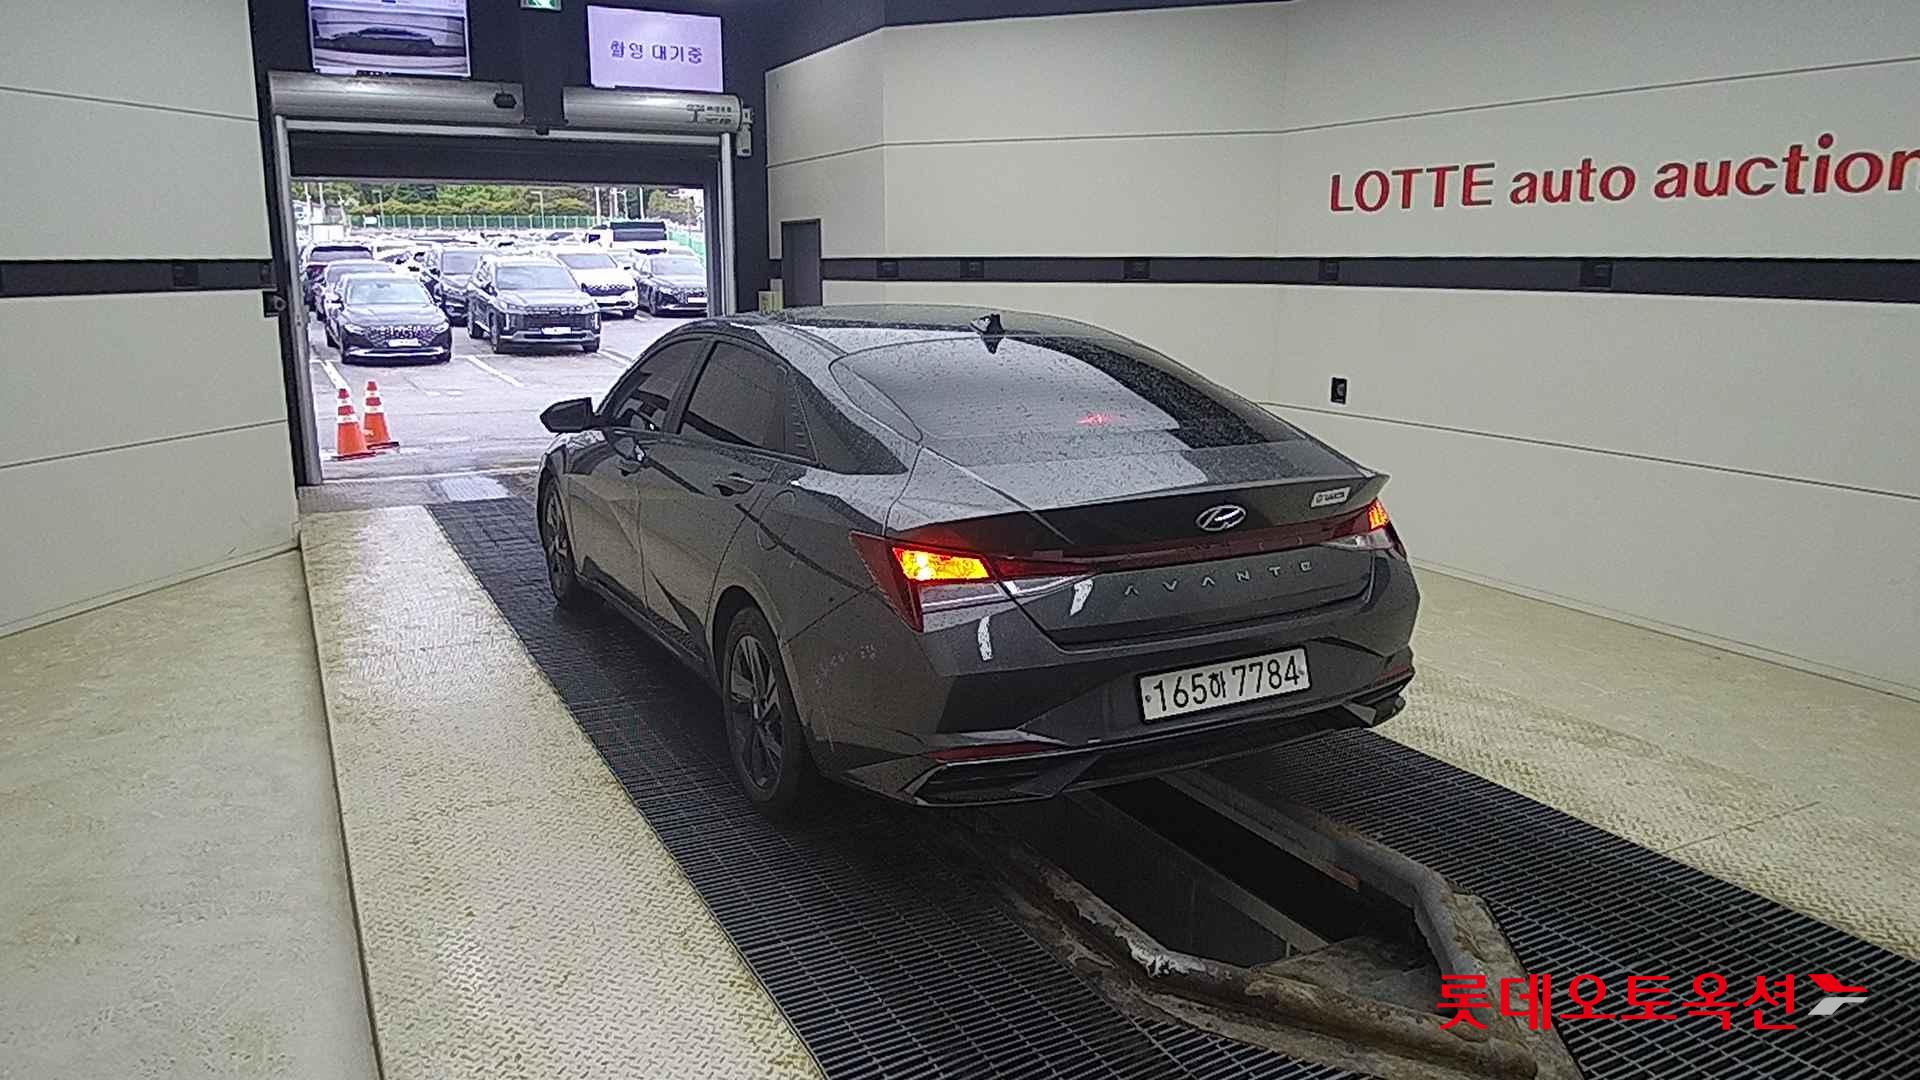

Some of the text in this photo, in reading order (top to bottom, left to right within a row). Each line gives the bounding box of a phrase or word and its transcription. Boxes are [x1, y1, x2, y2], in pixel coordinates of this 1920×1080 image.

[651, 44, 703, 64] 대기중
[1331, 162, 1495, 212] LOTTE
[1509, 157, 1636, 205] auto
[1123, 559, 1312, 597] AVANTE
[1231, 655, 1300, 697] 7784
